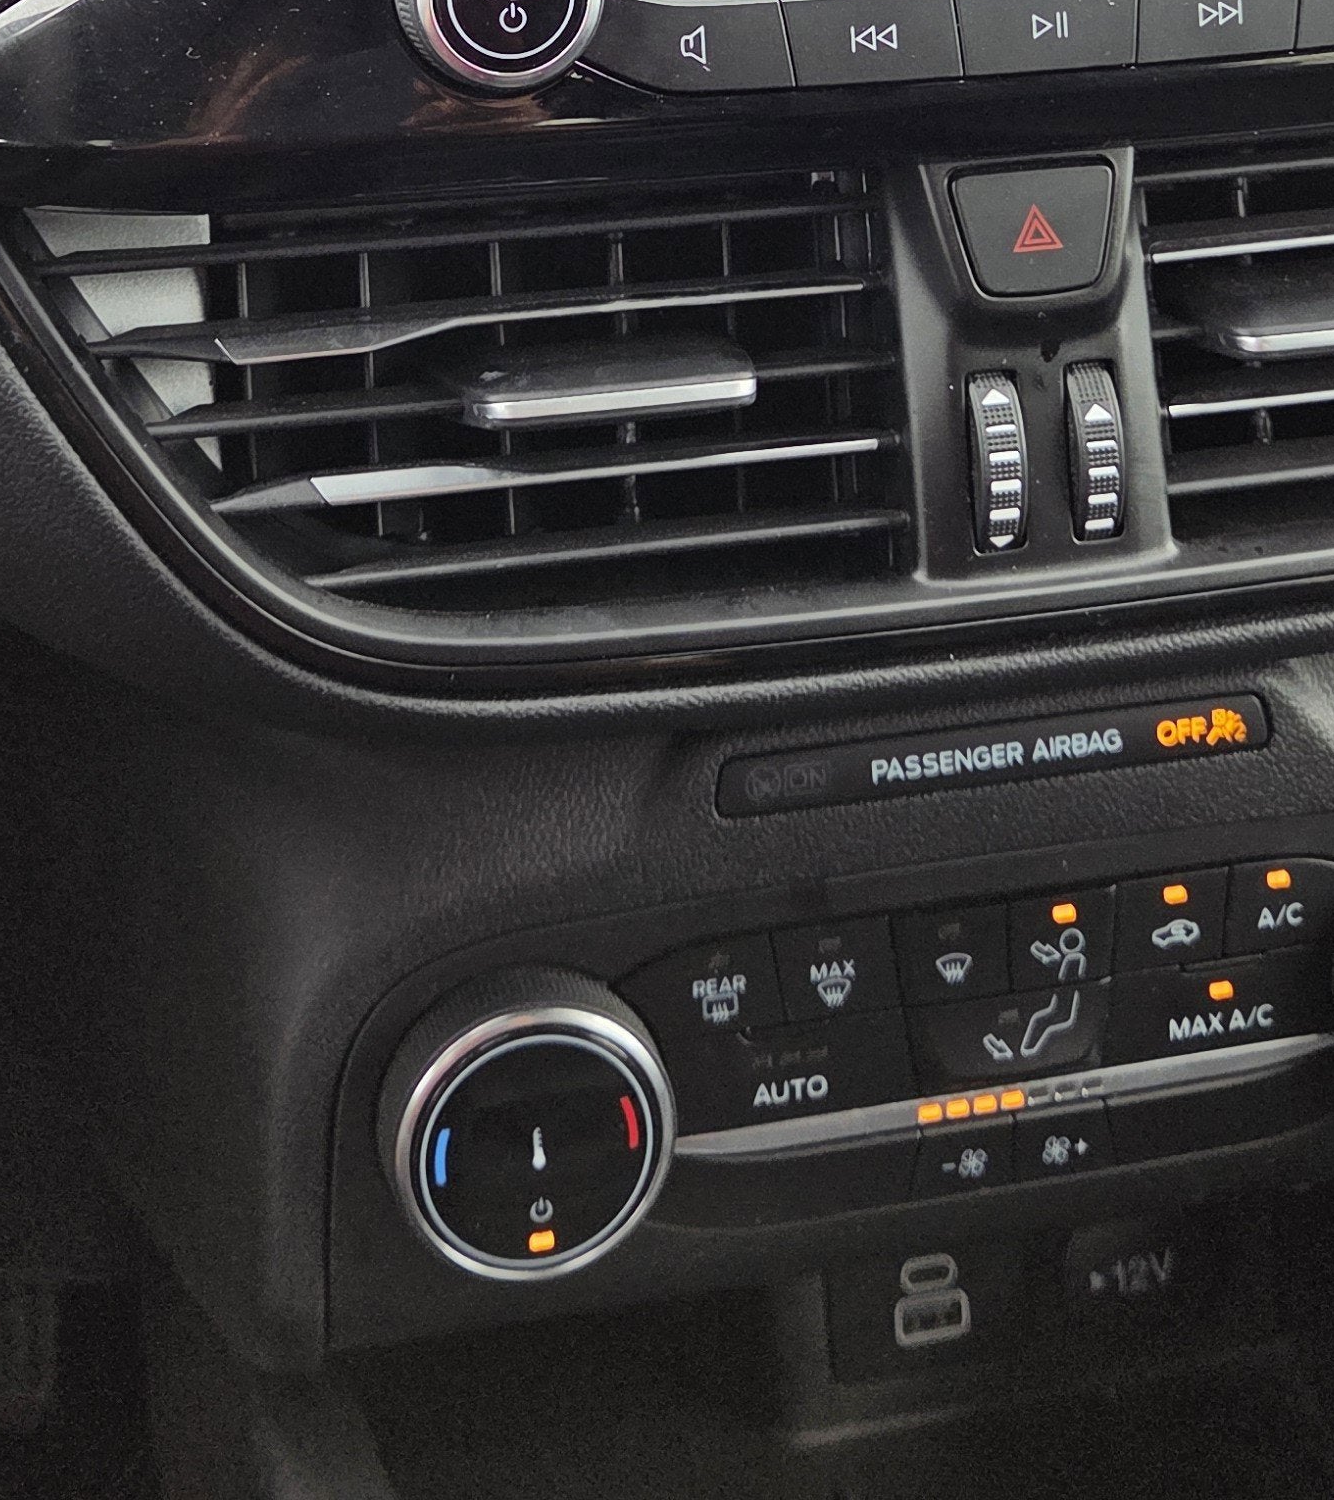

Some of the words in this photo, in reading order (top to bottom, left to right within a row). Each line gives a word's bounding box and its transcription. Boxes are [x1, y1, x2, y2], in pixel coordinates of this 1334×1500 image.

[871, 740, 1025, 787] PASSENGER
[1032, 727, 1124, 764] AIRBAG
[1156, 715, 1208, 748] OFF
[1257, 901, 1304, 930] A/C
[692, 973, 747, 999] REAR
[809, 959, 856, 983] MAX
[1168, 1010, 1223, 1042] MAX
[1228, 1003, 1275, 1034] A/C
[752, 1074, 829, 1108] AUTO
